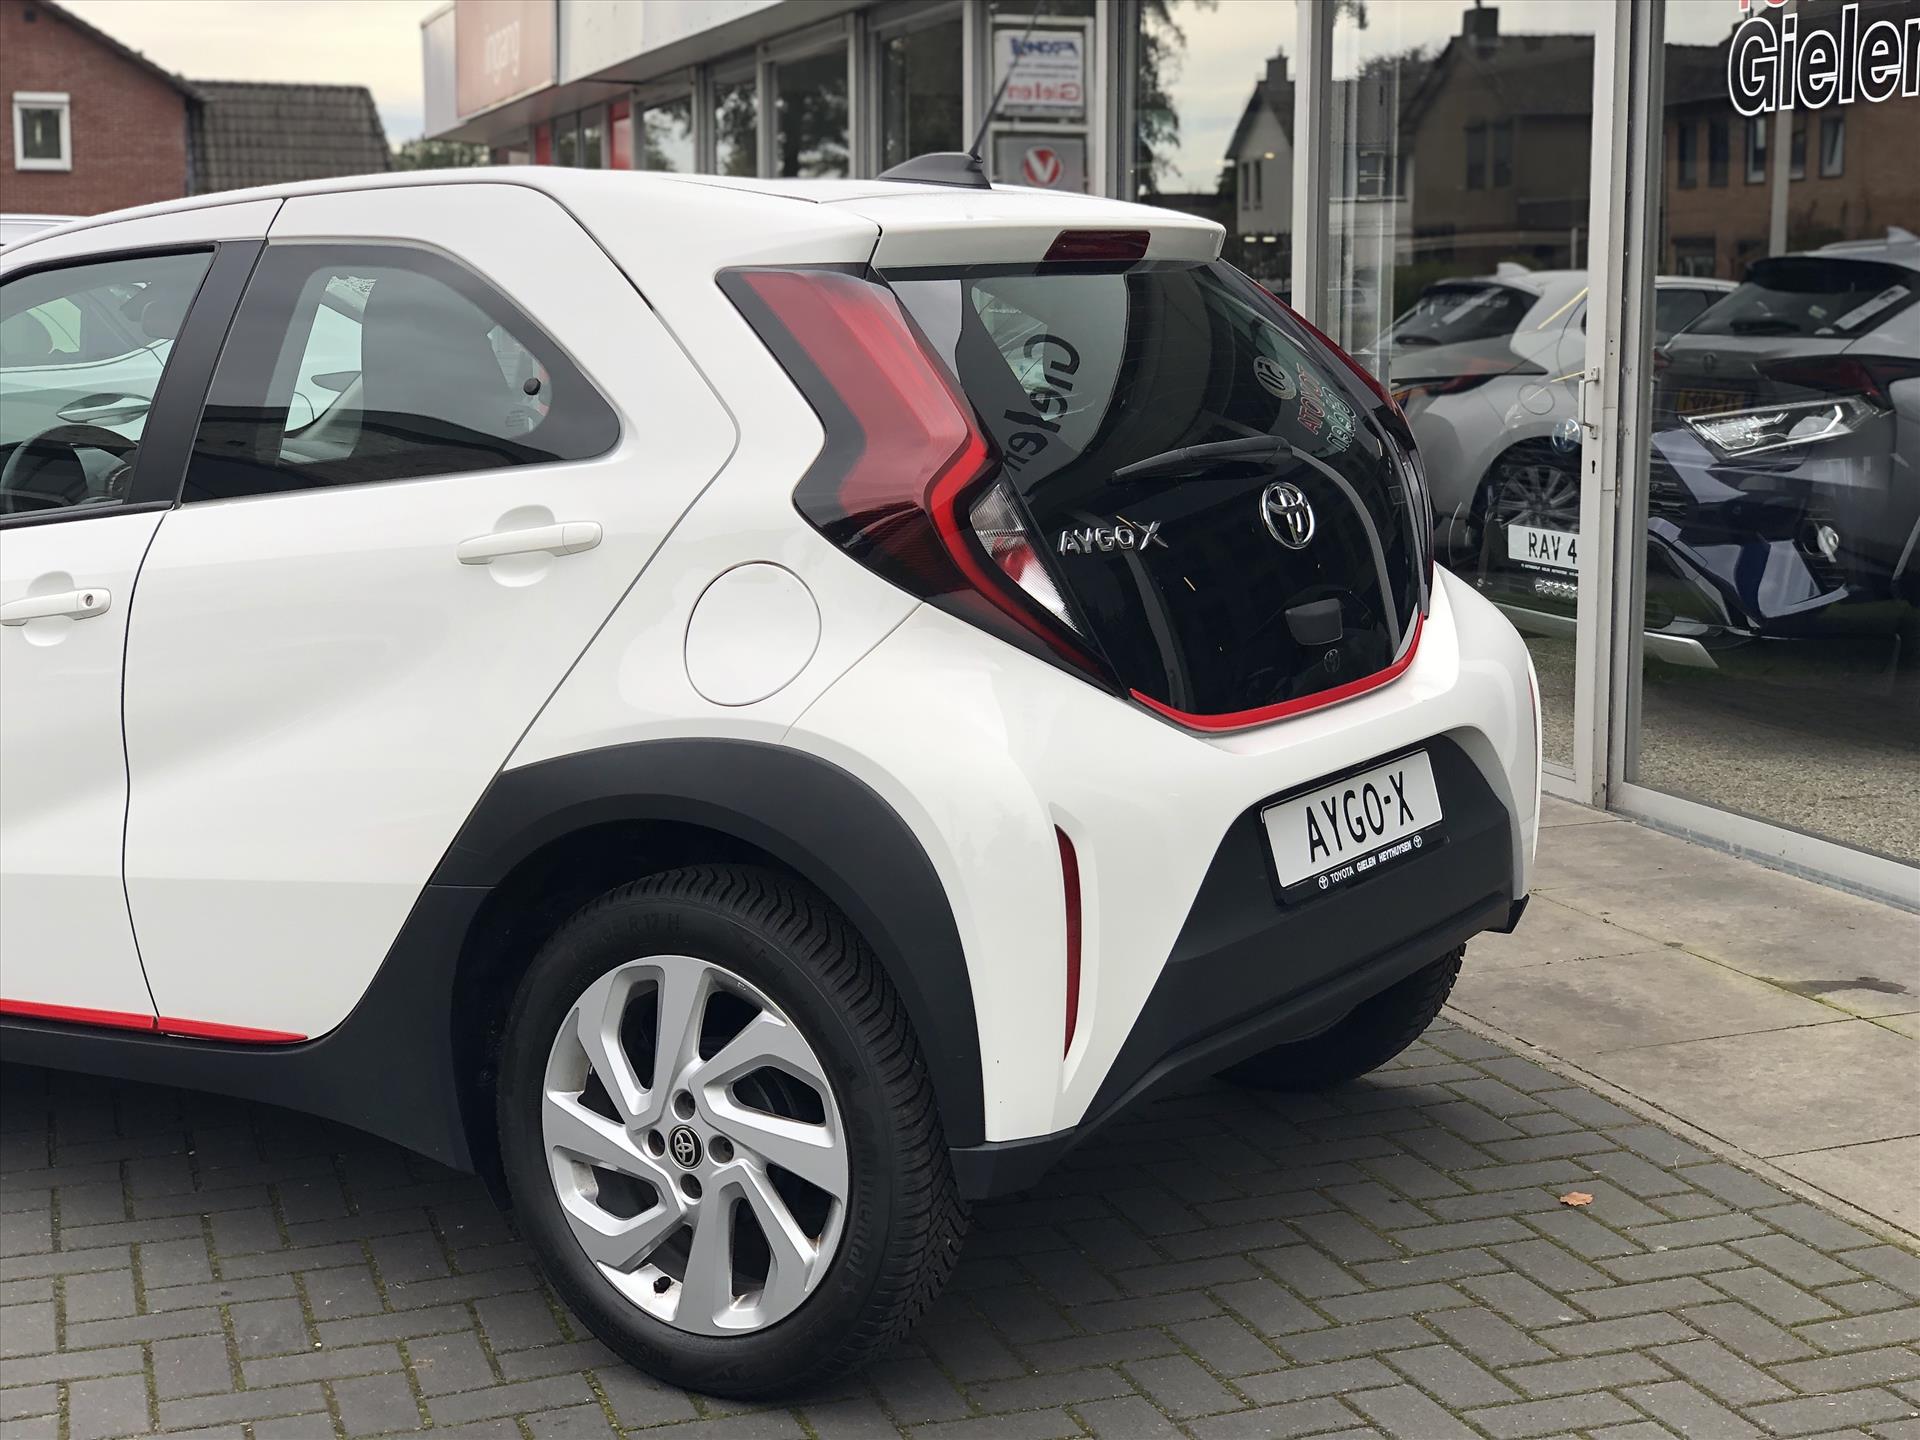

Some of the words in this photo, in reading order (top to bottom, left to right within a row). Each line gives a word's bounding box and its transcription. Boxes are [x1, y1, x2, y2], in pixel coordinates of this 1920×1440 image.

[1528, 531, 1561, 561] RAV
[1567, 538, 1577, 565] 4
[1305, 770, 1415, 864] AYGO-X
[1329, 865, 1355, 884] TOYOTA
[1356, 855, 1377, 873] GIELEN
